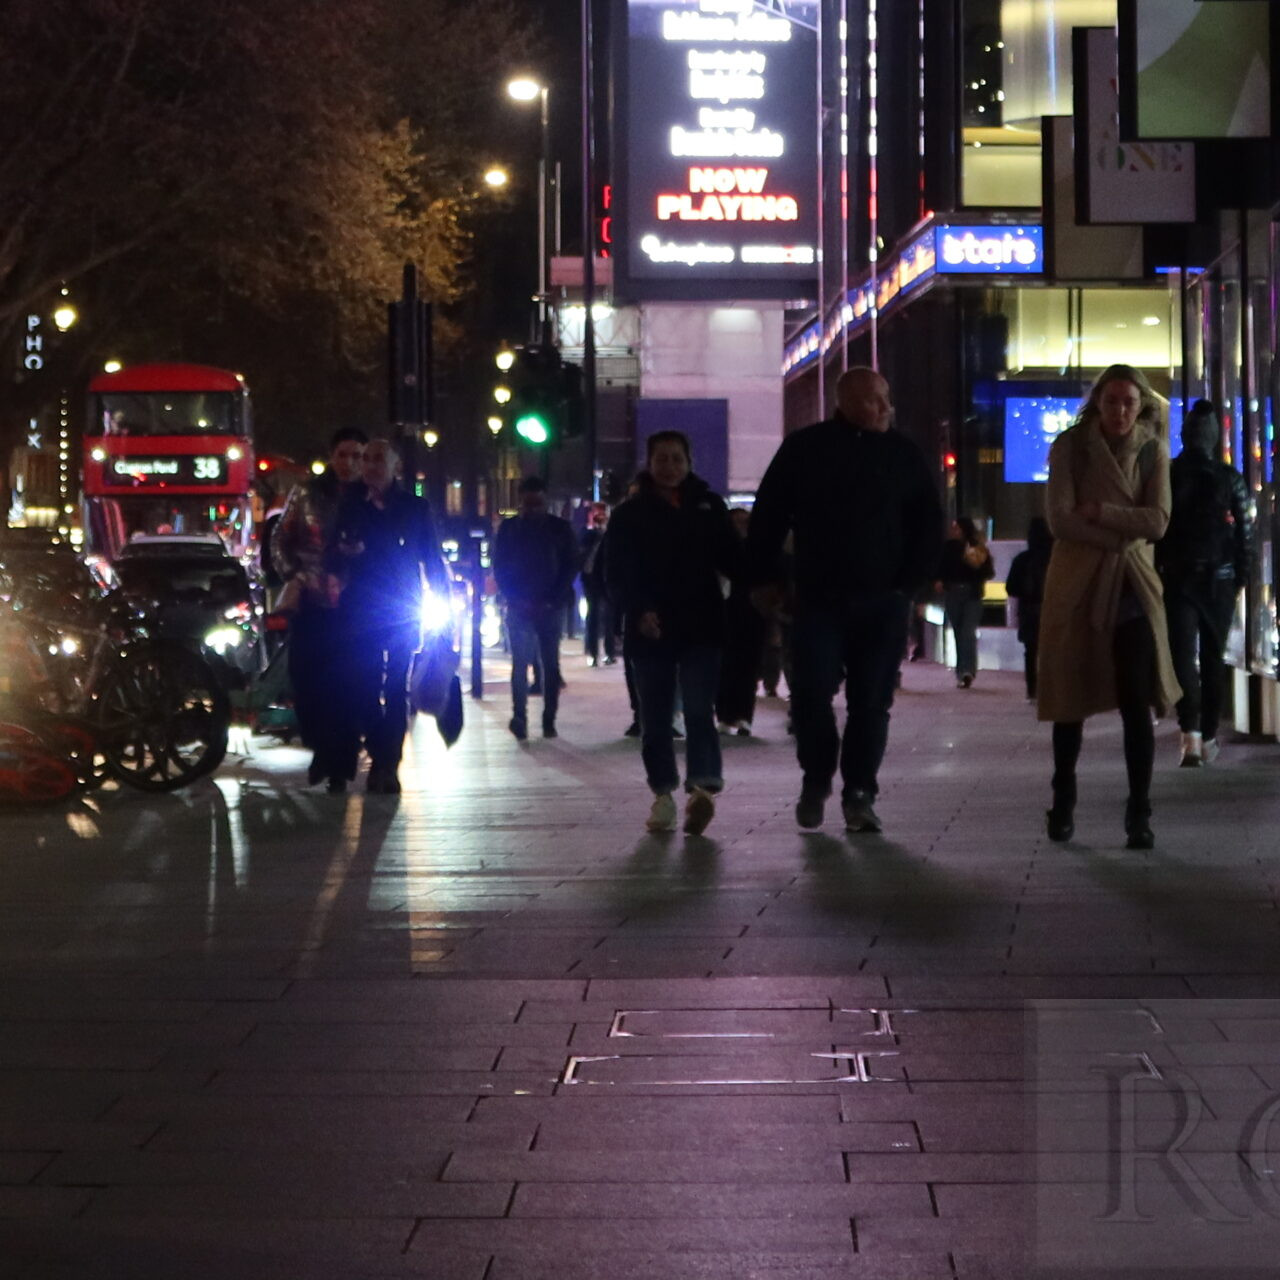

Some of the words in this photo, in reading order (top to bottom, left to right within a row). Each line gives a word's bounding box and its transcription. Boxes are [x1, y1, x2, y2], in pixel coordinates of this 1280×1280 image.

[689, 167, 768, 193] NOW
[657, 194, 798, 221] PLAYING
[194, 456, 220, 479] 38
